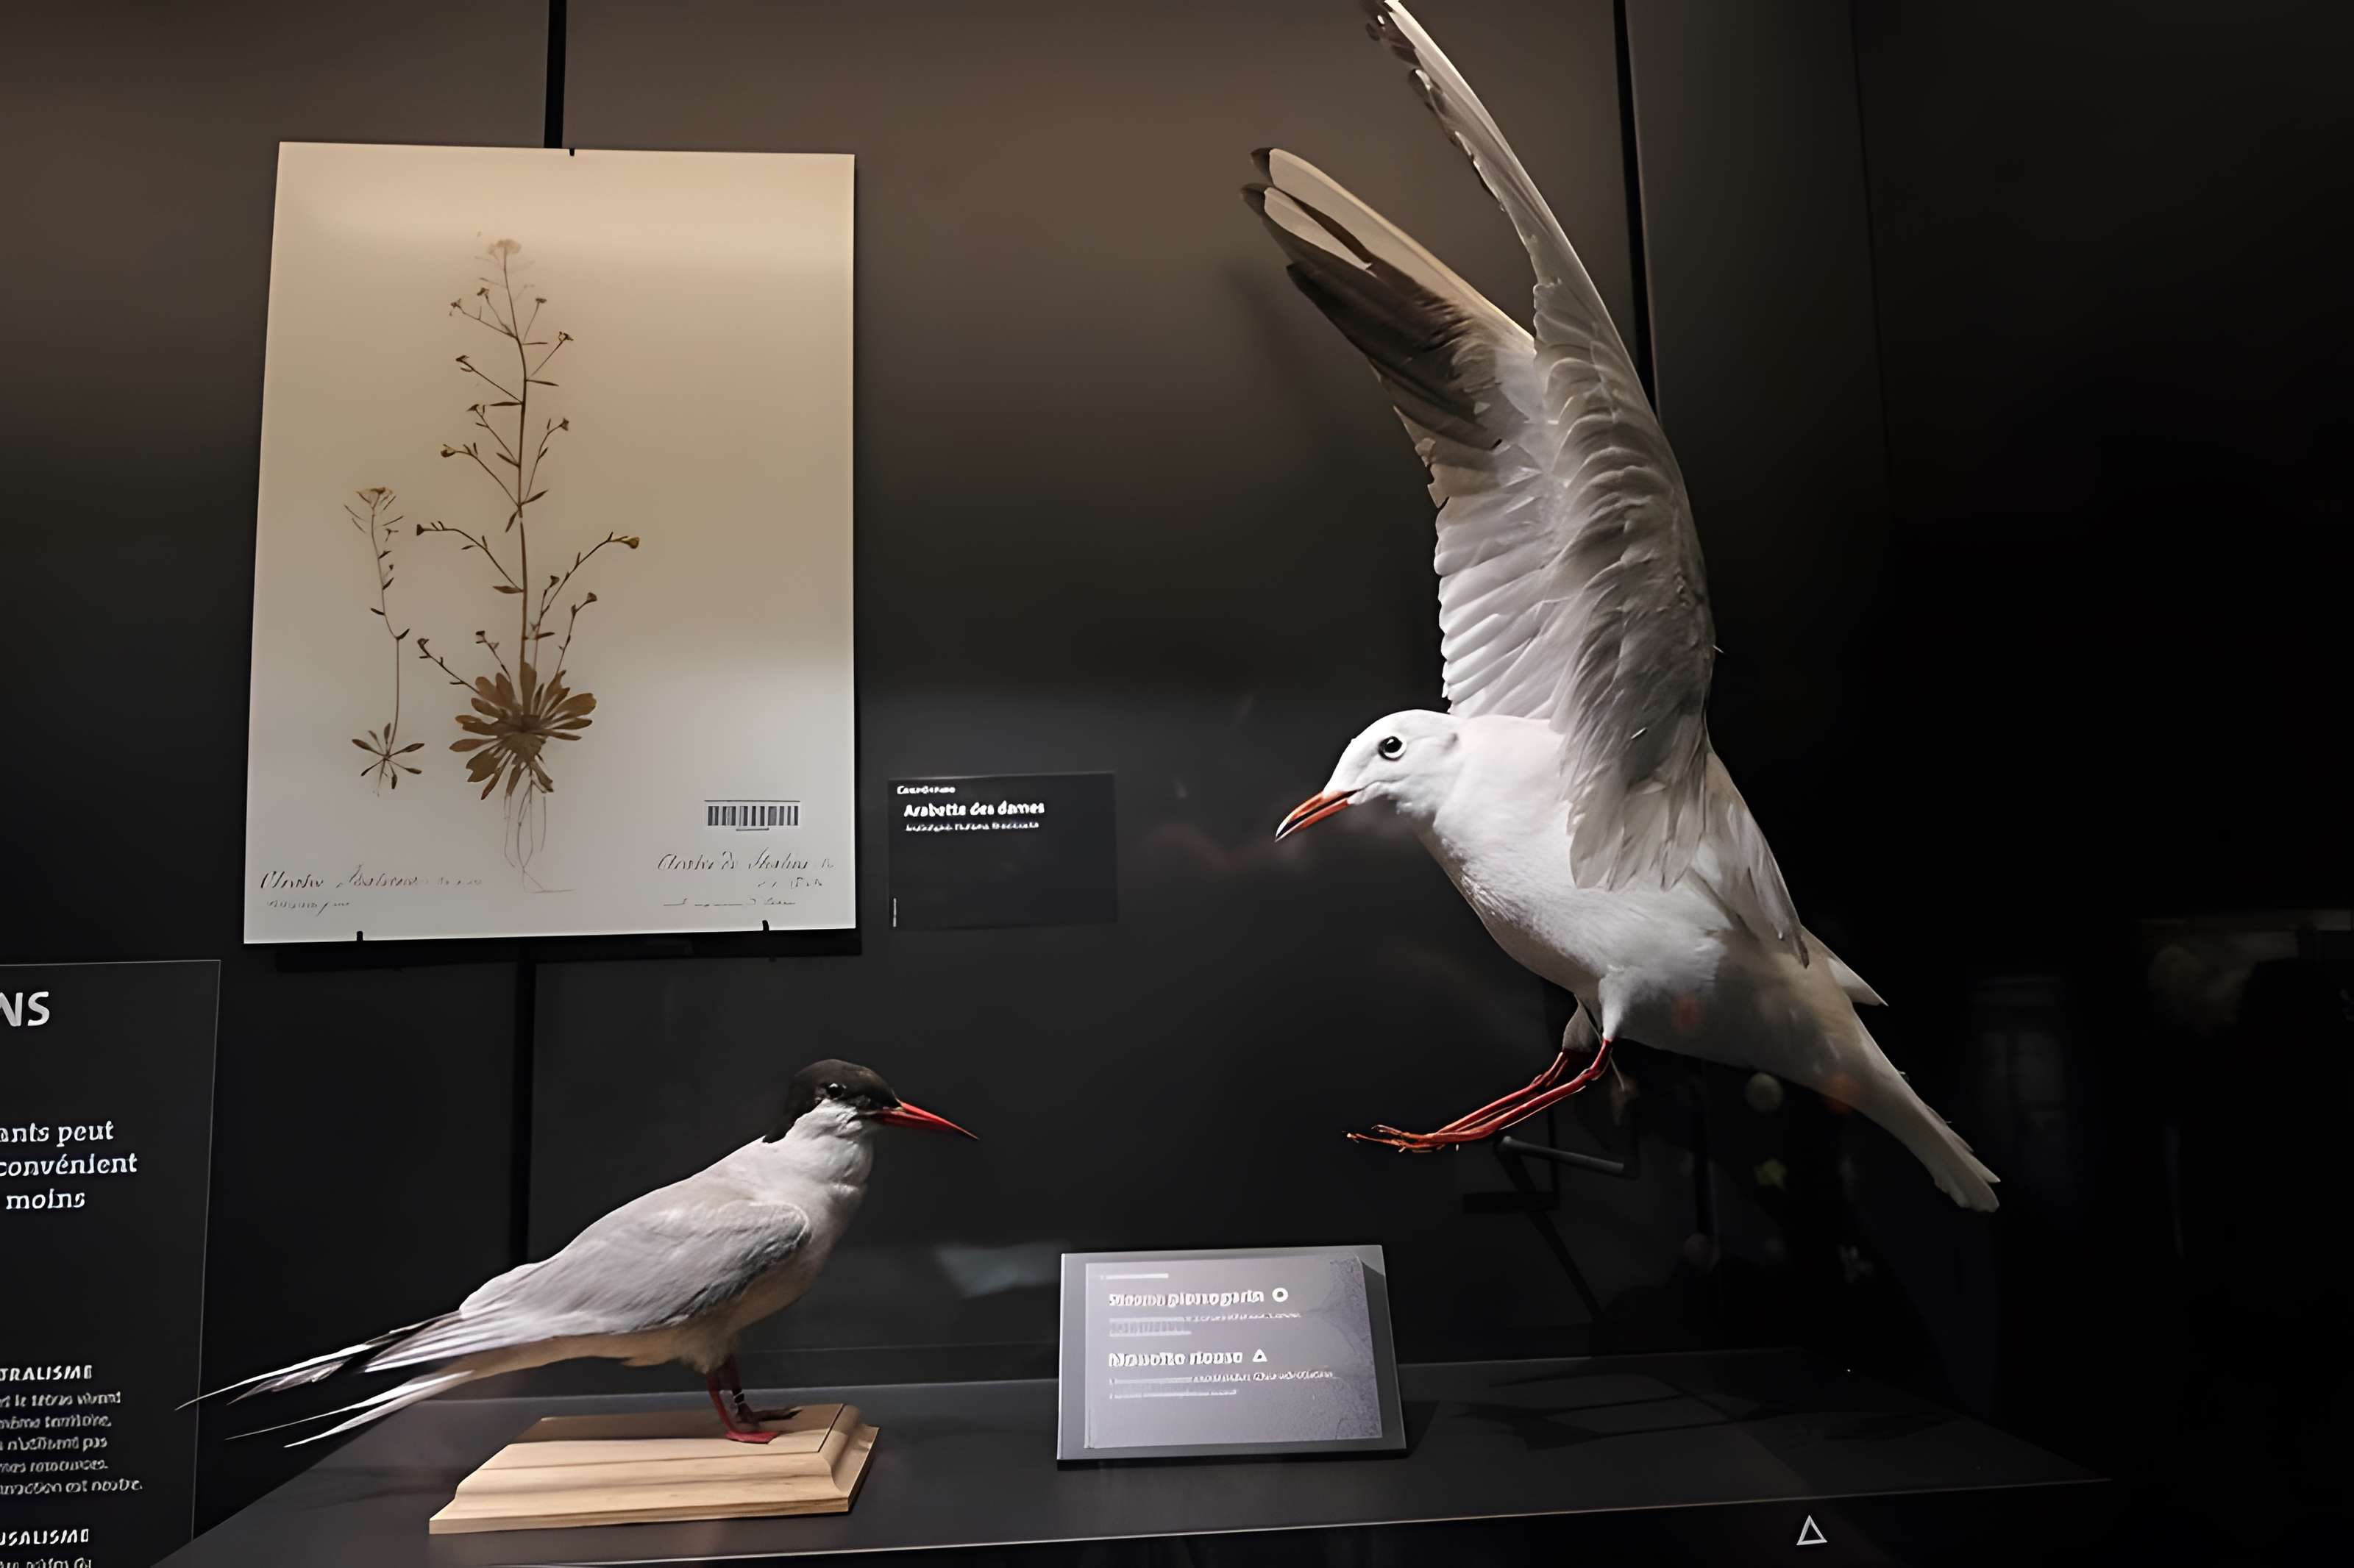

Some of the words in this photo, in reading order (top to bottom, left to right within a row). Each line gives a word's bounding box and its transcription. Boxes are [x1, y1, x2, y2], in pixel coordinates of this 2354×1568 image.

[56, 1120, 114, 1148] peut
[0, 1152, 138, 1177] convénient
[5, 1188, 85, 1210] moins
